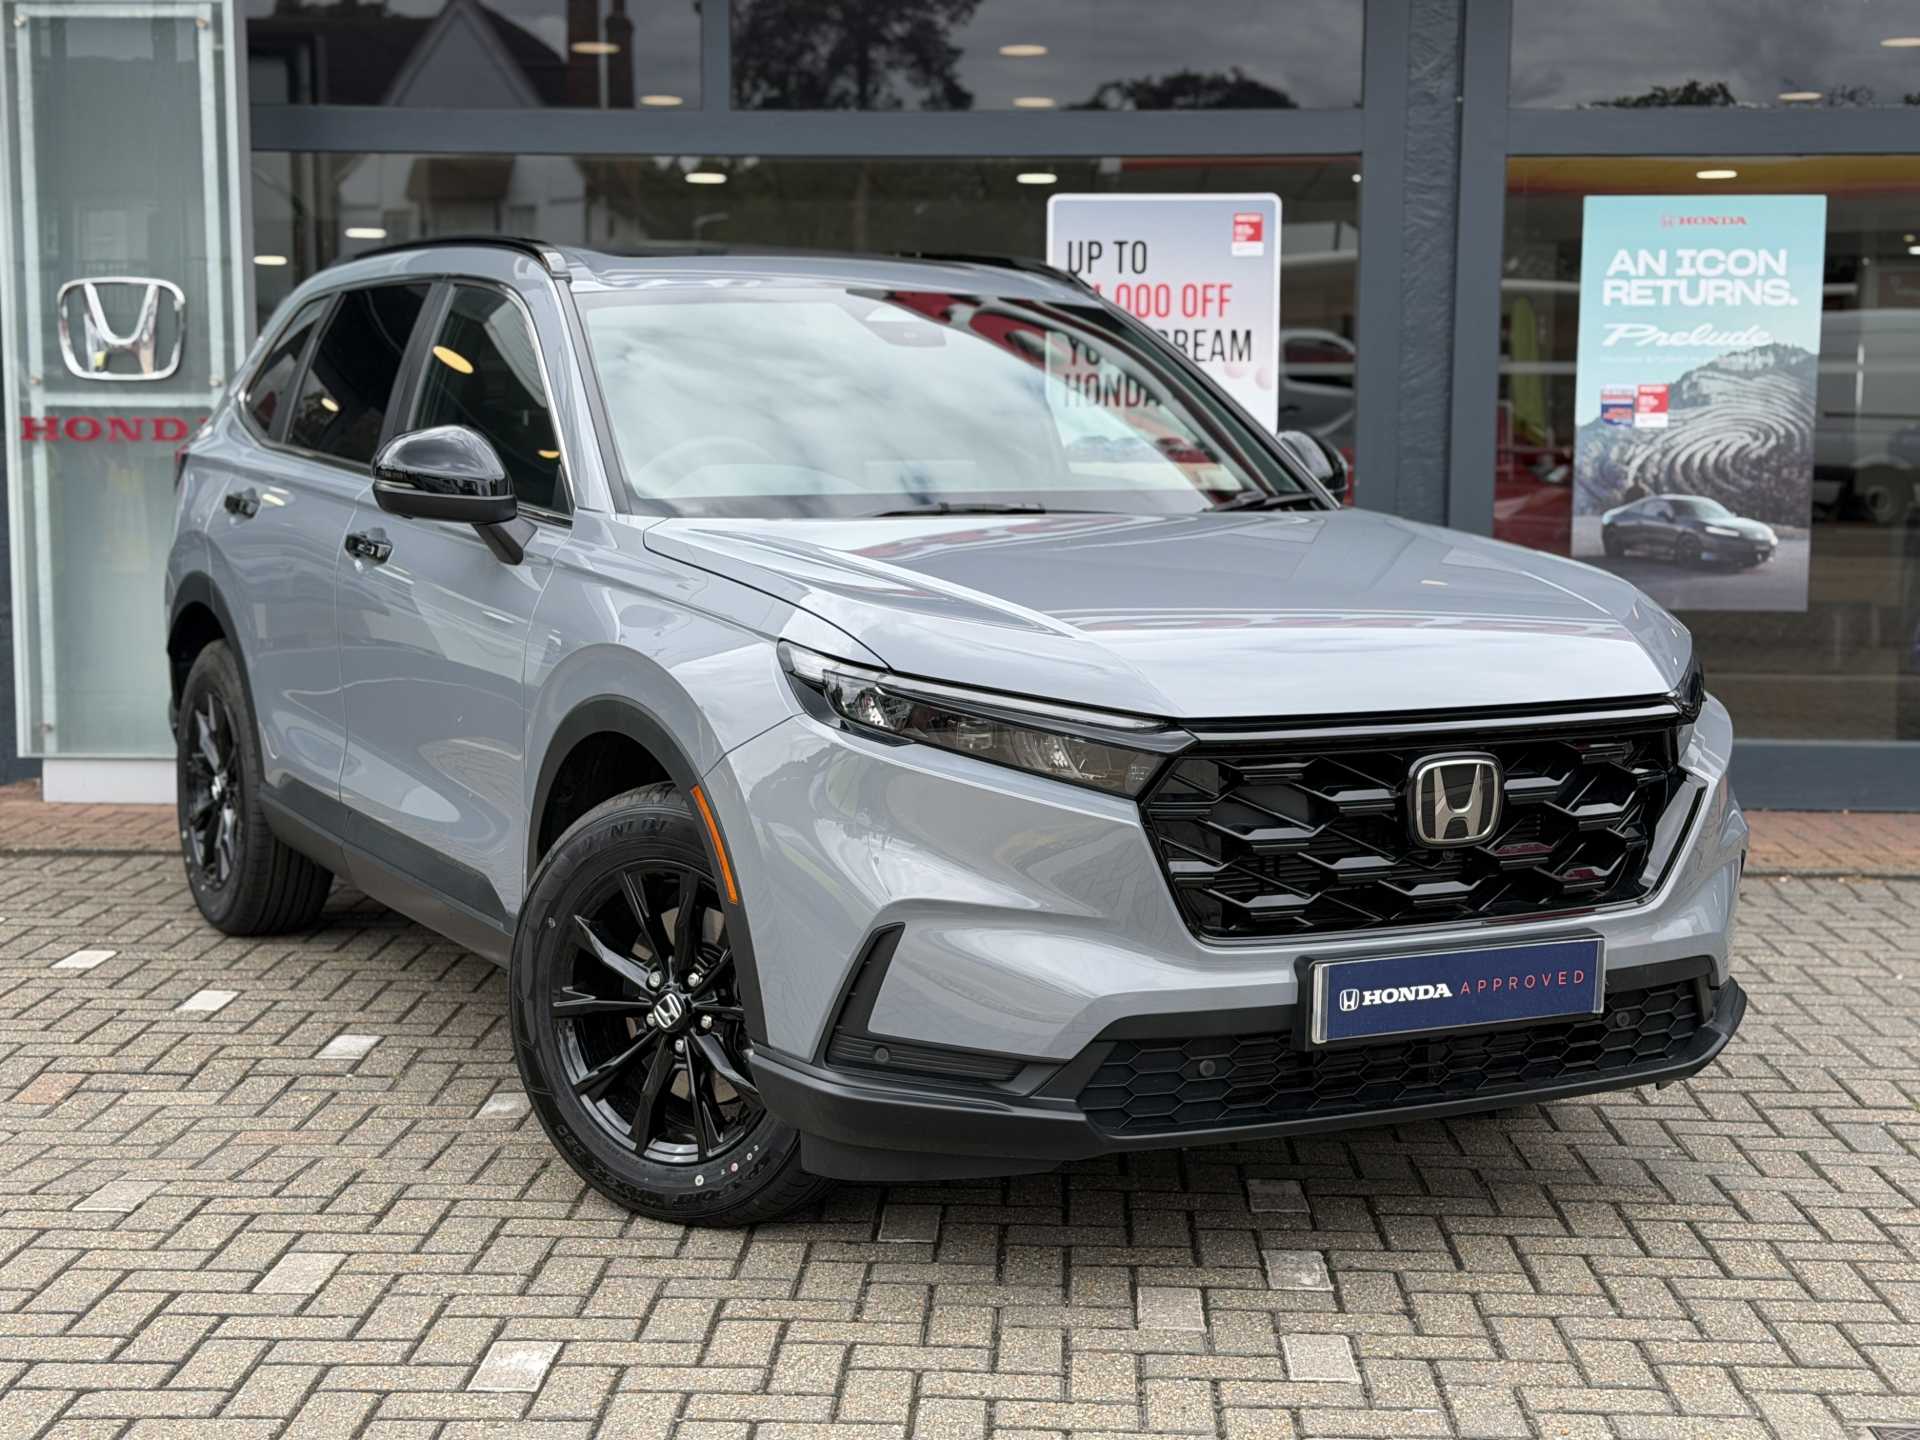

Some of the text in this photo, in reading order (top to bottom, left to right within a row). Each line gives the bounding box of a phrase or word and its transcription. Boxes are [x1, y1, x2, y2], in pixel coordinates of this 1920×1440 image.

[1677, 215, 1748, 226] HONDA
[1067, 240, 1147, 275] UP TO
[1606, 249, 1788, 277] AN ICON
[1182, 283, 1233, 318] OFF
[1601, 279, 1799, 306] RETURNS.
[1155, 329, 1252, 362] REAM
[1600, 322, 1772, 348] Prelude
[20, 415, 209, 443] HOND
[1361, 970, 1585, 1006] HONDA APPROVED
